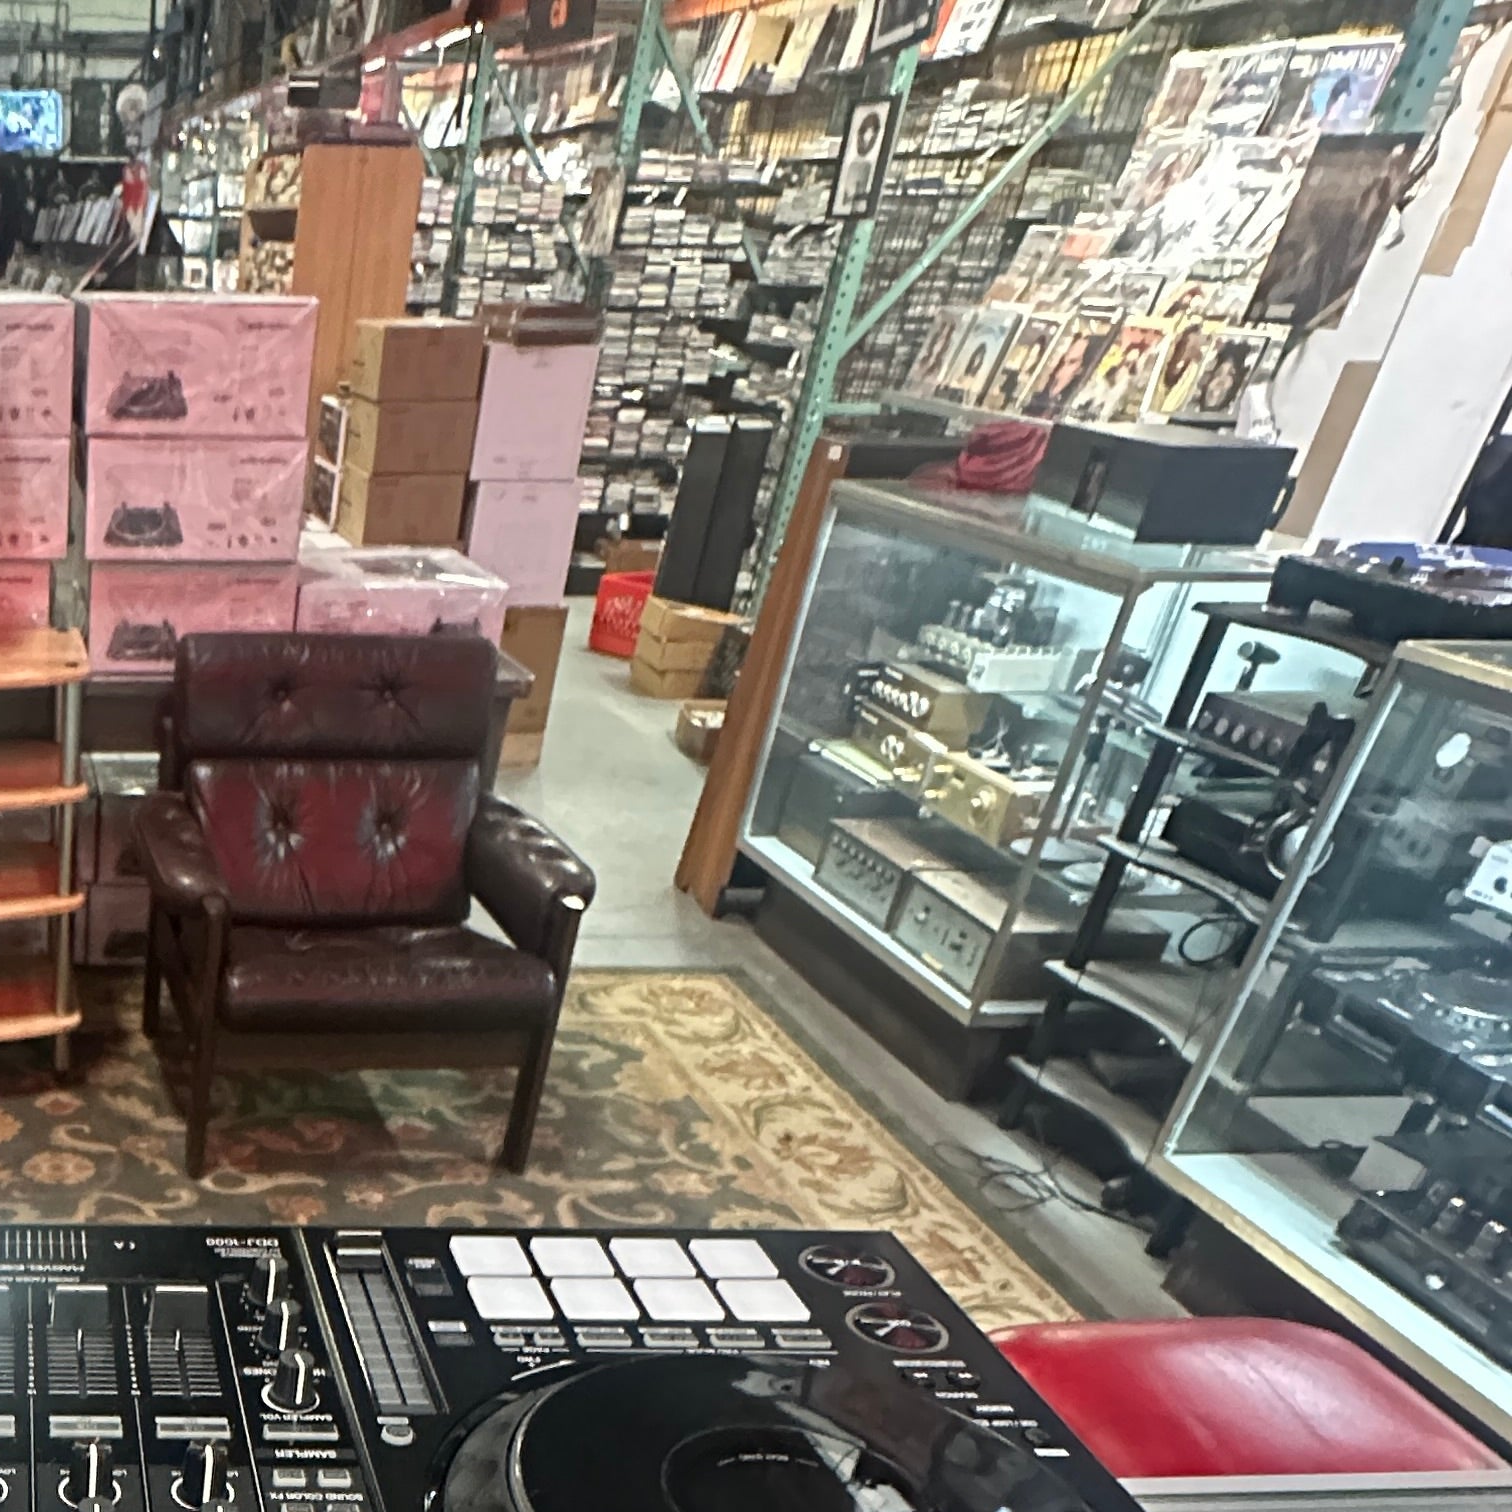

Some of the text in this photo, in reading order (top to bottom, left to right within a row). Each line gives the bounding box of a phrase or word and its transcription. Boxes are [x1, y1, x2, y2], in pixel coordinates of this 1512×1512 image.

[283, 1413, 333, 1422] SAMPLER
[274, 1449, 336, 1458] SAMPLER
[285, 1492, 323, 1500] COLOR
